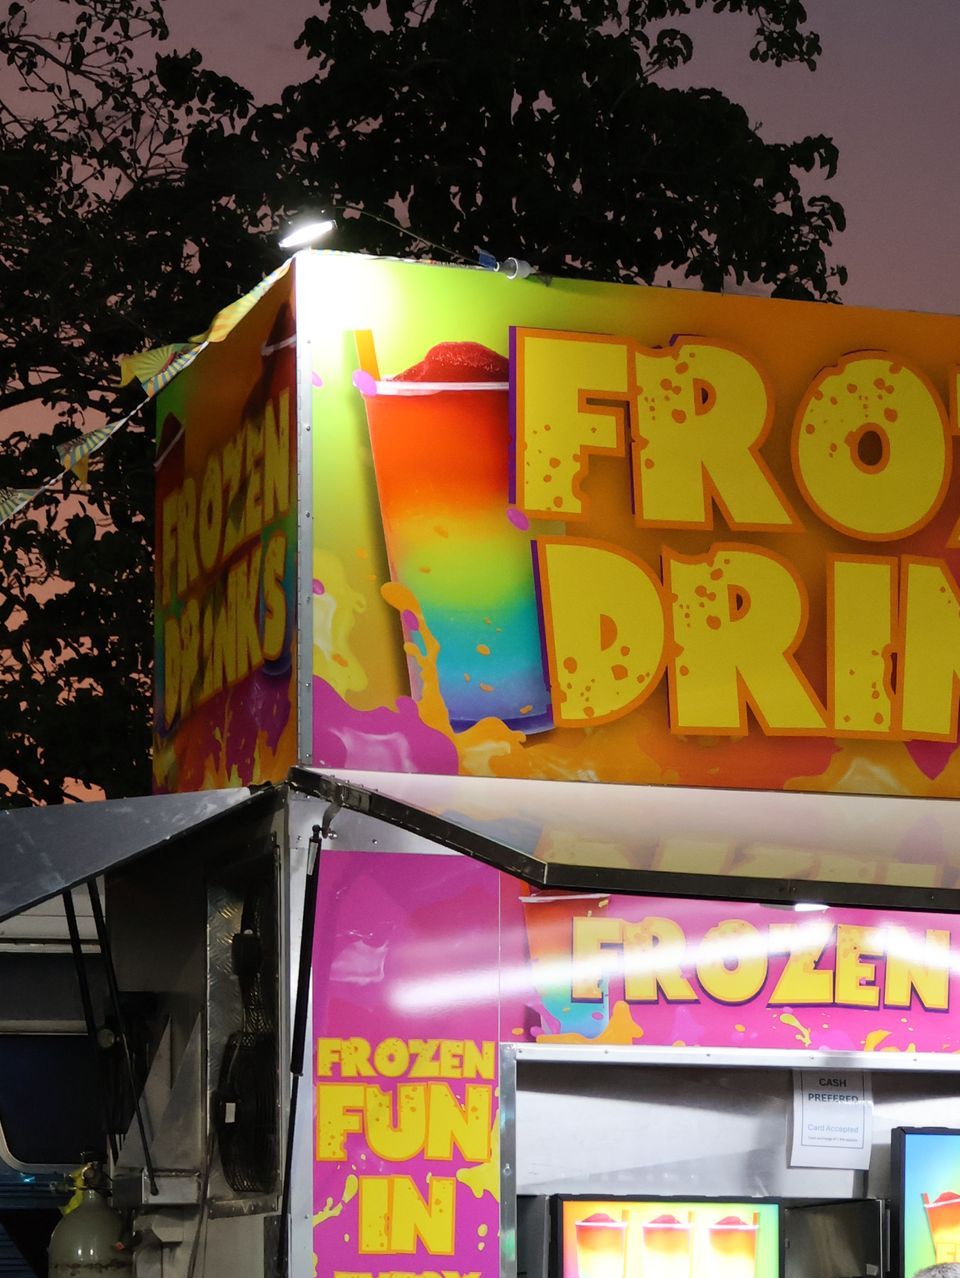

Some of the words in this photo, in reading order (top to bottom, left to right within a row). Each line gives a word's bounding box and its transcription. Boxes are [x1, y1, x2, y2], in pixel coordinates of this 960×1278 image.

[162, 386, 290, 606] FROZEN
[163, 532, 289, 730] DRINKS
[571, 916, 951, 1013] FROZEN
[316, 1036, 496, 1080] FROZEN
[818, 1078, 847, 1088] CASH
[315, 1081, 493, 1162] FUN
[808, 1123, 825, 1132] Card
[826, 1125, 859, 1134] Accepted
[358, 1174, 457, 1256] IN
